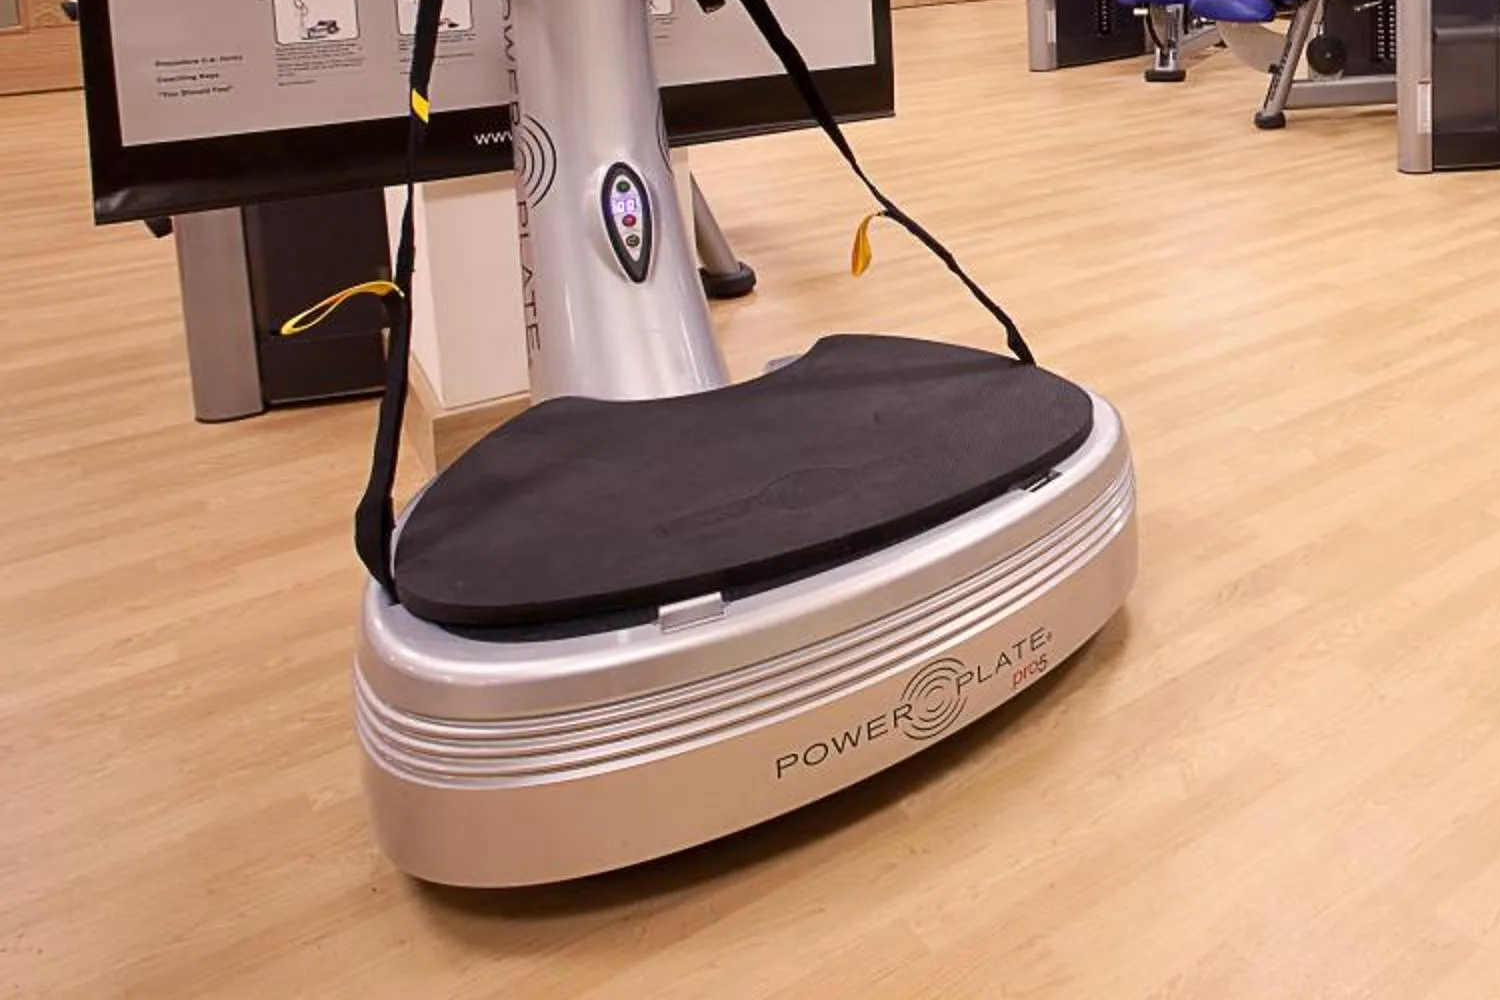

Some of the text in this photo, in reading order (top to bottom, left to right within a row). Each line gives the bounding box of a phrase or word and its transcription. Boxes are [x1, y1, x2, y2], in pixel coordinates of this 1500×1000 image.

[516, 199, 542, 349] PLATE
[1011, 653, 1049, 690] pro5
[775, 702, 914, 780] POWER
